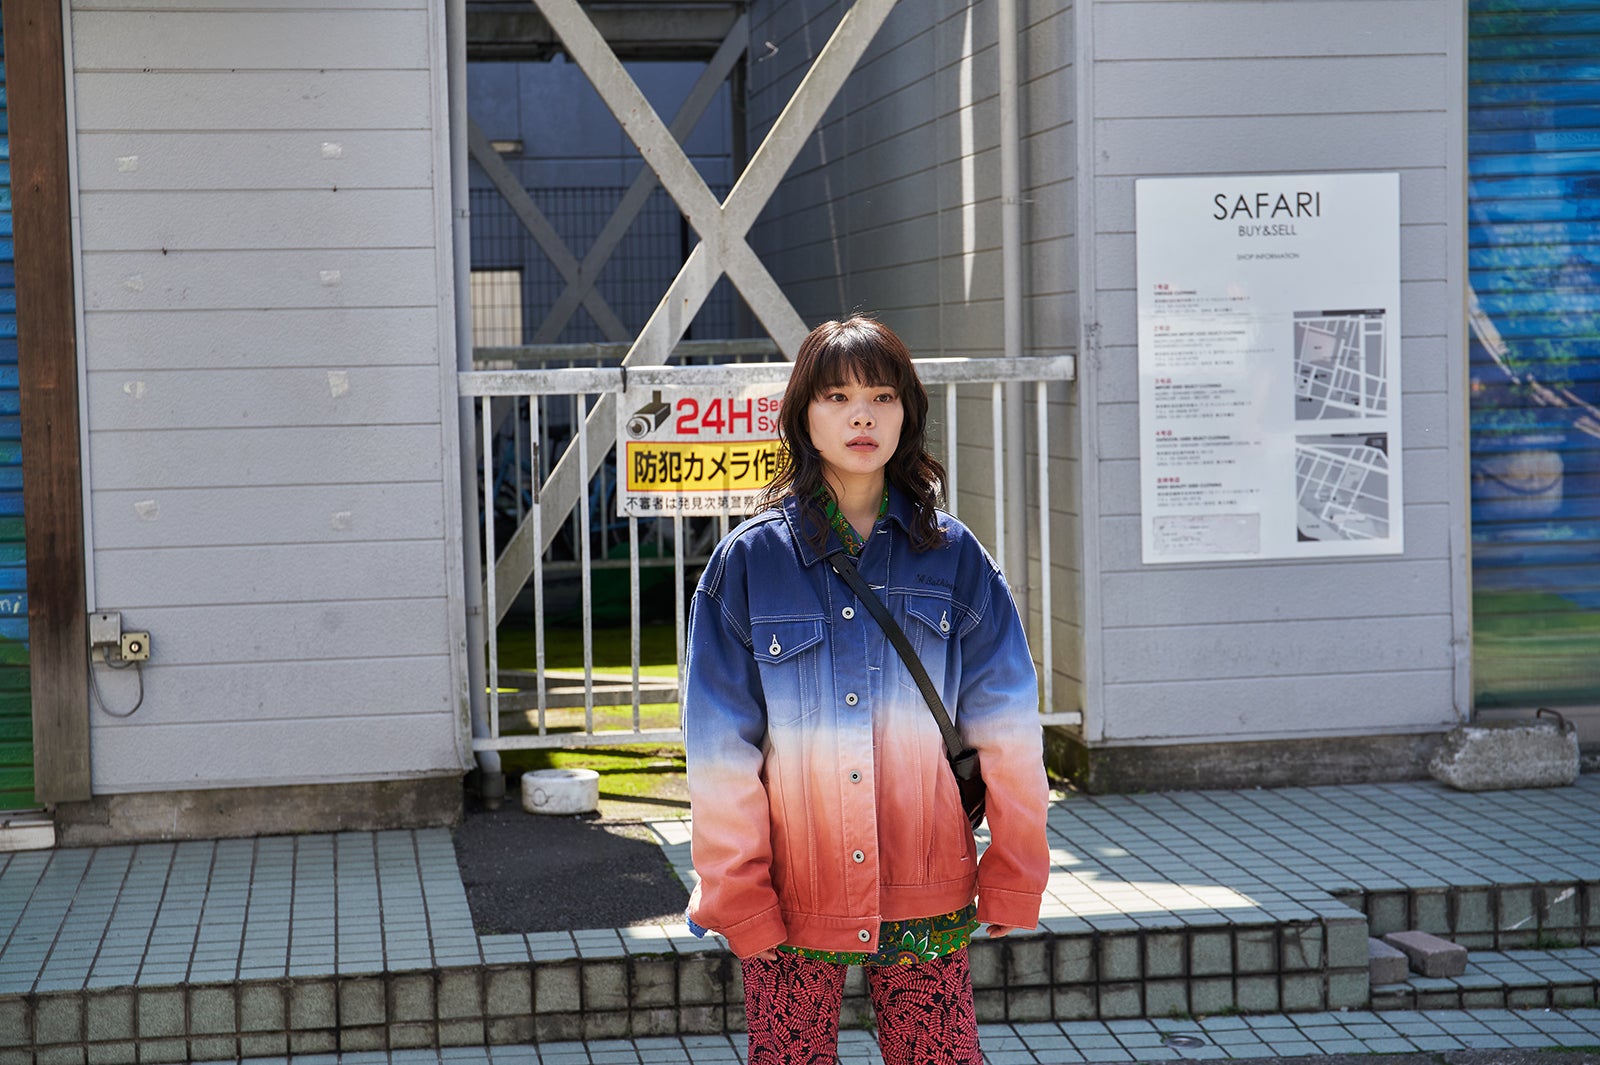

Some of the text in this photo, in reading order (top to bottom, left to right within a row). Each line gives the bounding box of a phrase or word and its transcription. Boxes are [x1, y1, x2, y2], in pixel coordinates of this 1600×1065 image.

[1213, 191, 1321, 221] SAFARI
[1238, 224, 1297, 237] BUY&SELL
[676, 398, 752, 435] 24H
[758, 415, 781, 433] Sy
